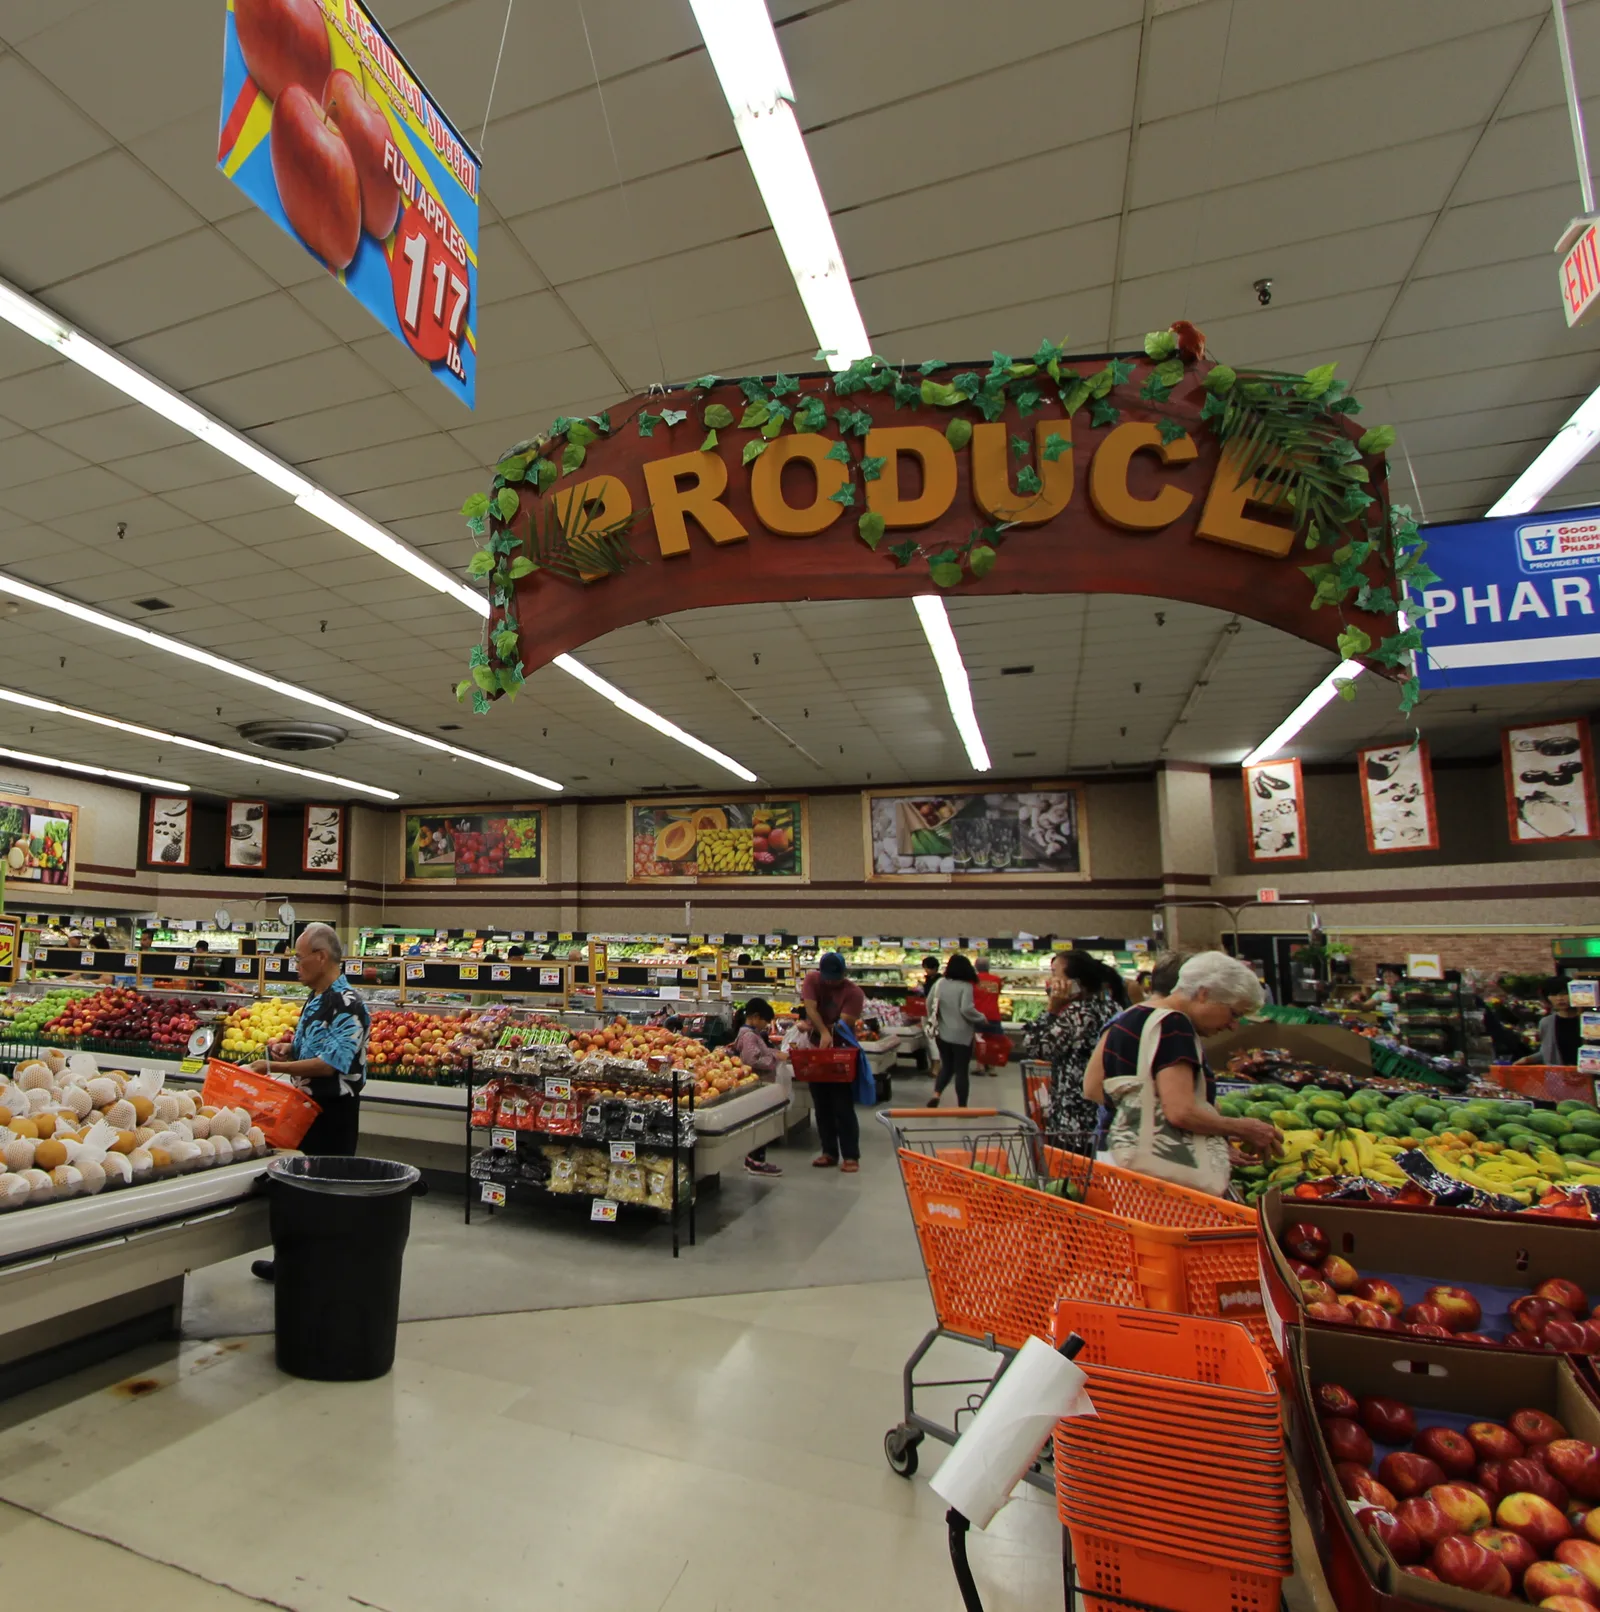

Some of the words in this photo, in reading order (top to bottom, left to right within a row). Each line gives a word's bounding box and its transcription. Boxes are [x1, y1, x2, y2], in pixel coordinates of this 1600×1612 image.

[425, 97, 476, 199] Special
[384, 139, 416, 202] FUJI
[418, 186, 467, 266] APPLES
[1565, 226, 1600, 314] EXIT
[446, 341, 465, 379] lb.
[551, 419, 1312, 581] PRODUCE
[1558, 525, 1597, 535] GOOD
[1529, 558, 1580, 570] PROVIDER
[1422, 574, 1600, 628] PHAR
